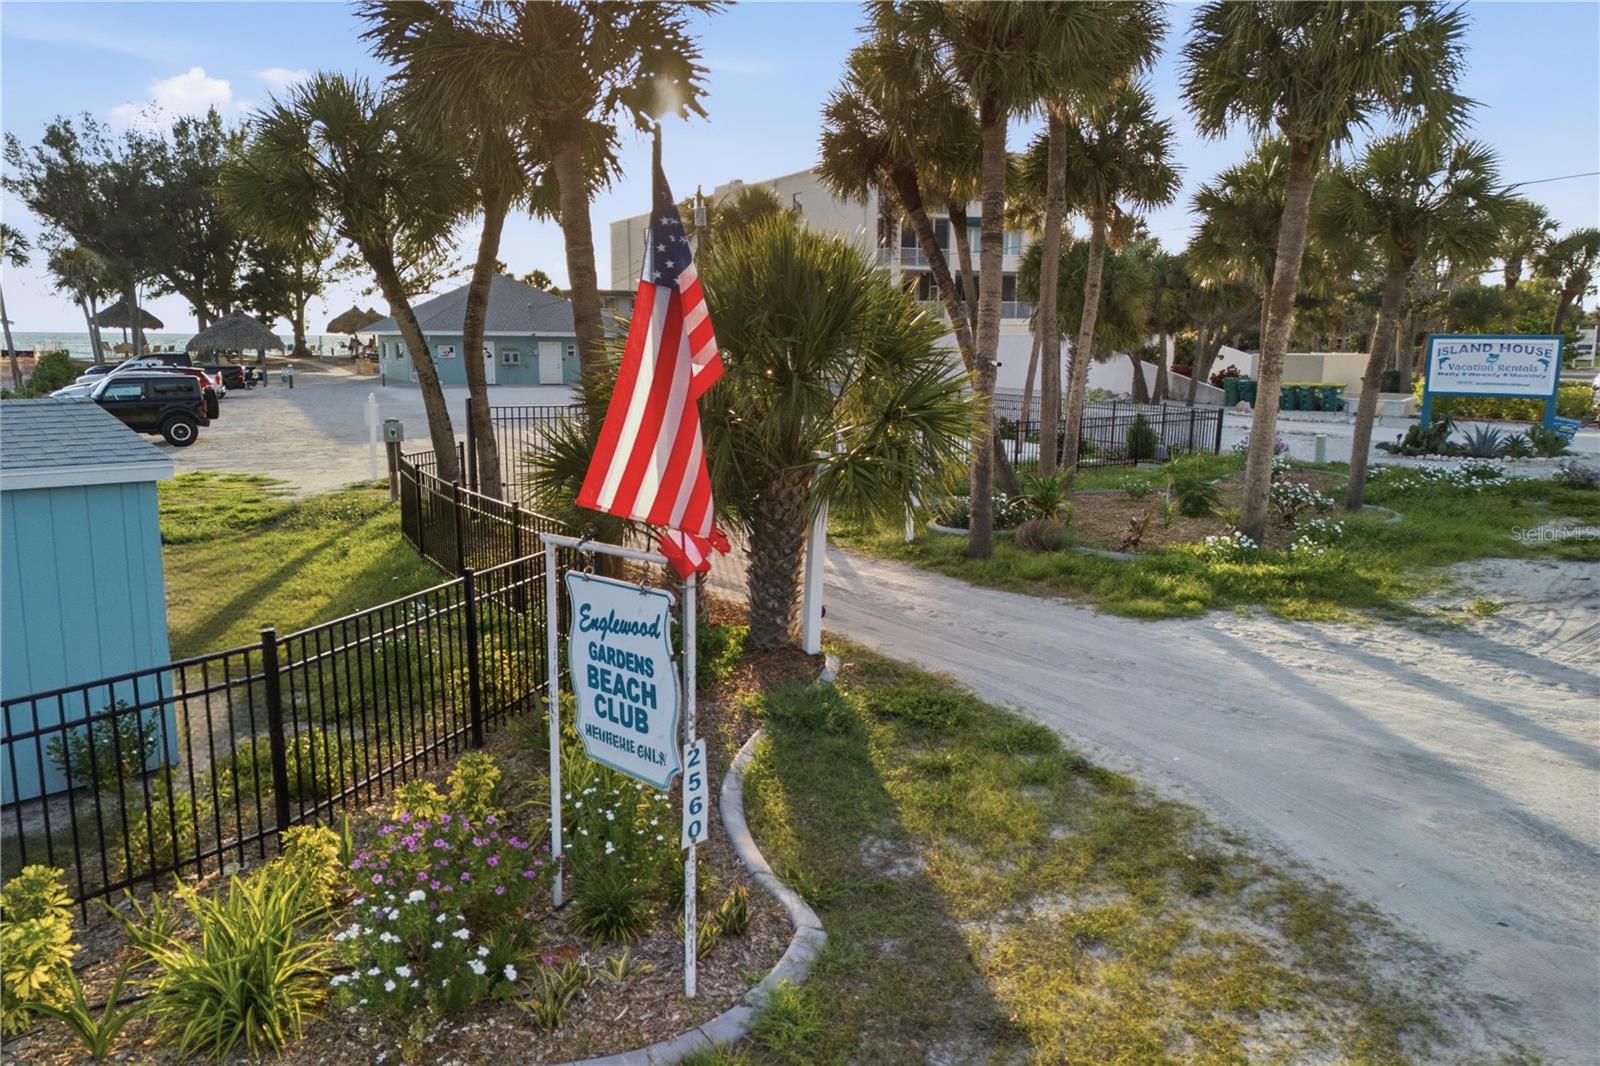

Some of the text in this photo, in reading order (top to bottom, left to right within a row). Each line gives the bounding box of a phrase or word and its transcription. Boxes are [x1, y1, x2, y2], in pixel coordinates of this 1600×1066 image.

[1437, 343, 1553, 359] ISLAND HOUSE
[1448, 363, 1538, 373] Vacation Rentals
[579, 603, 661, 641] Englewood
[588, 641, 654, 678] GARDENS
[587, 664, 657, 710] BEACH
[594, 693, 649, 734] CLUB
[687, 747, 703, 839] 2560
